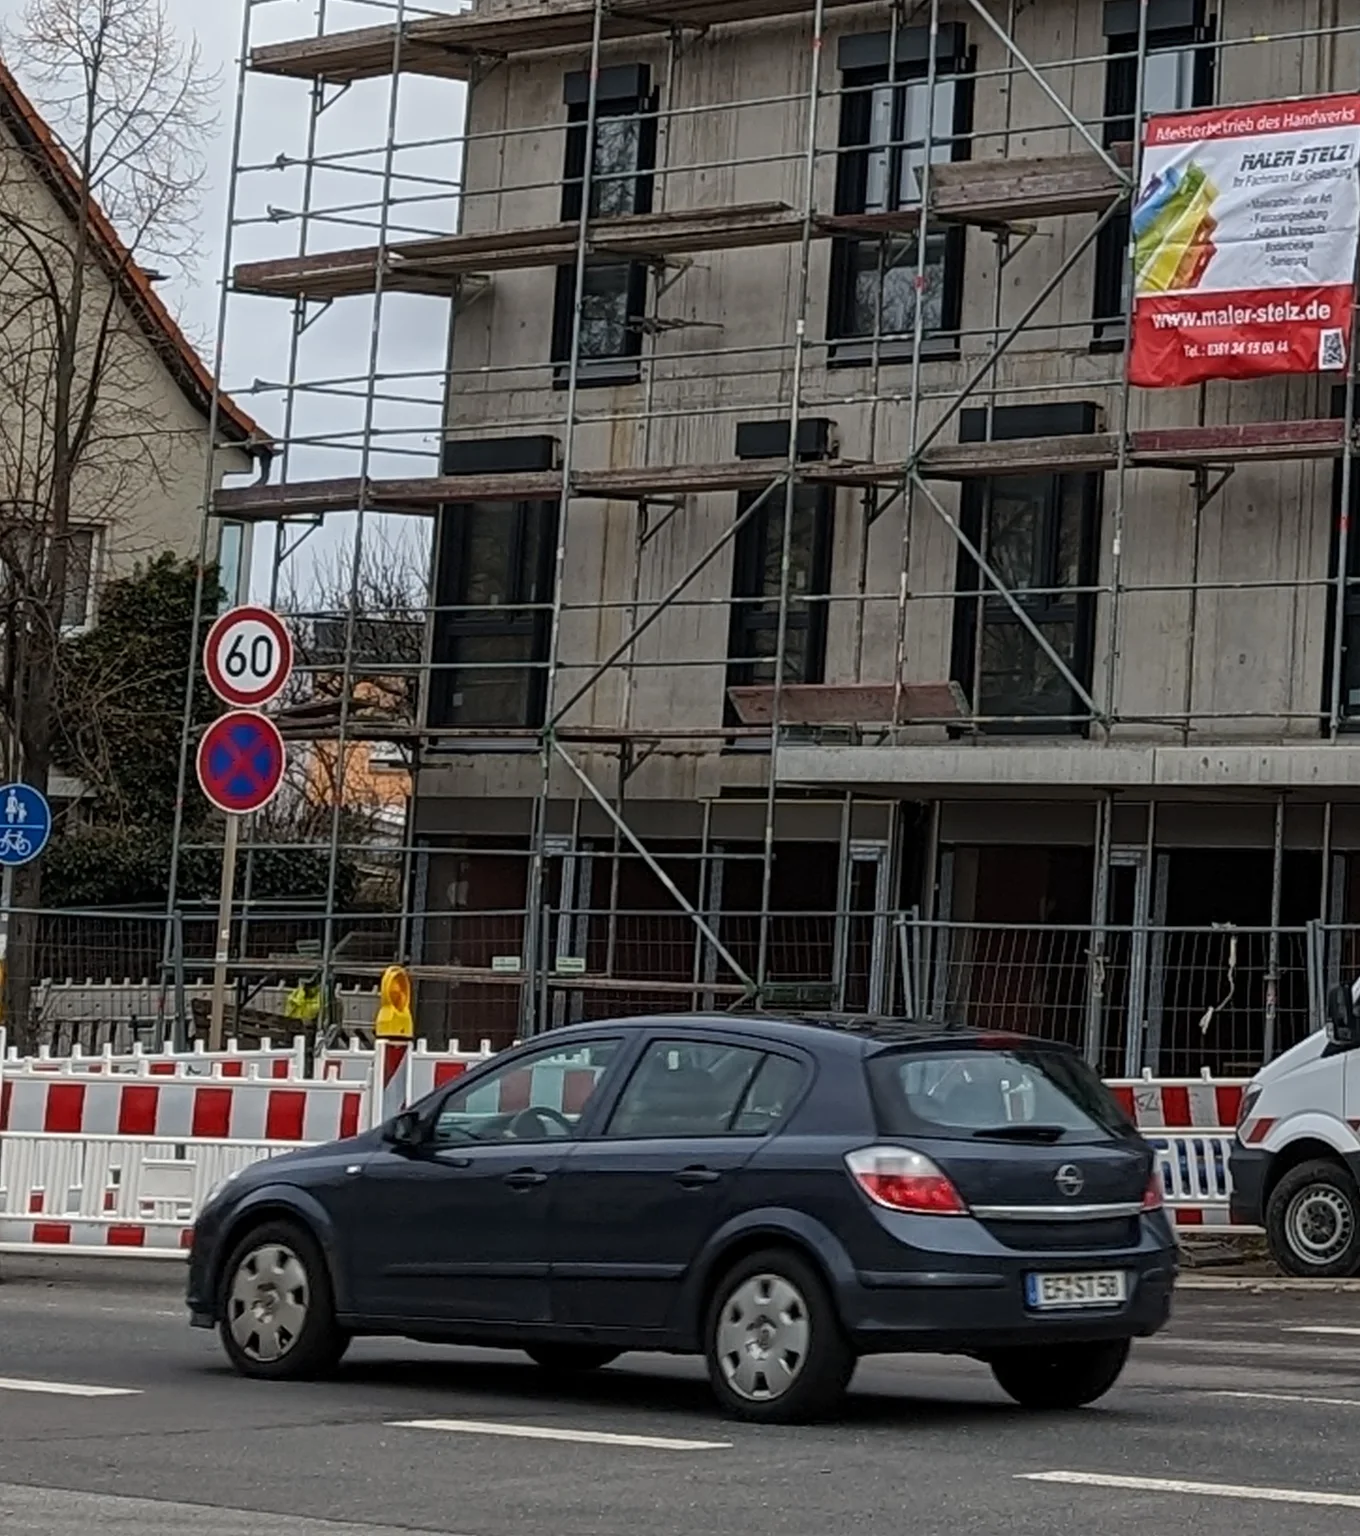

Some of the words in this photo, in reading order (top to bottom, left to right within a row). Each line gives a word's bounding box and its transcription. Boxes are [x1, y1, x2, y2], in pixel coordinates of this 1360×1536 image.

[1156, 115, 1254, 142] Meisterbetrieb
[1256, 114, 1280, 131] des
[1283, 107, 1355, 130] Handwerks
[1240, 150, 1296, 172] MALER
[1298, 145, 1350, 165] STELZ
[1151, 300, 1331, 329] www.maler-stelz.de
[224, 633, 273, 678] 60
